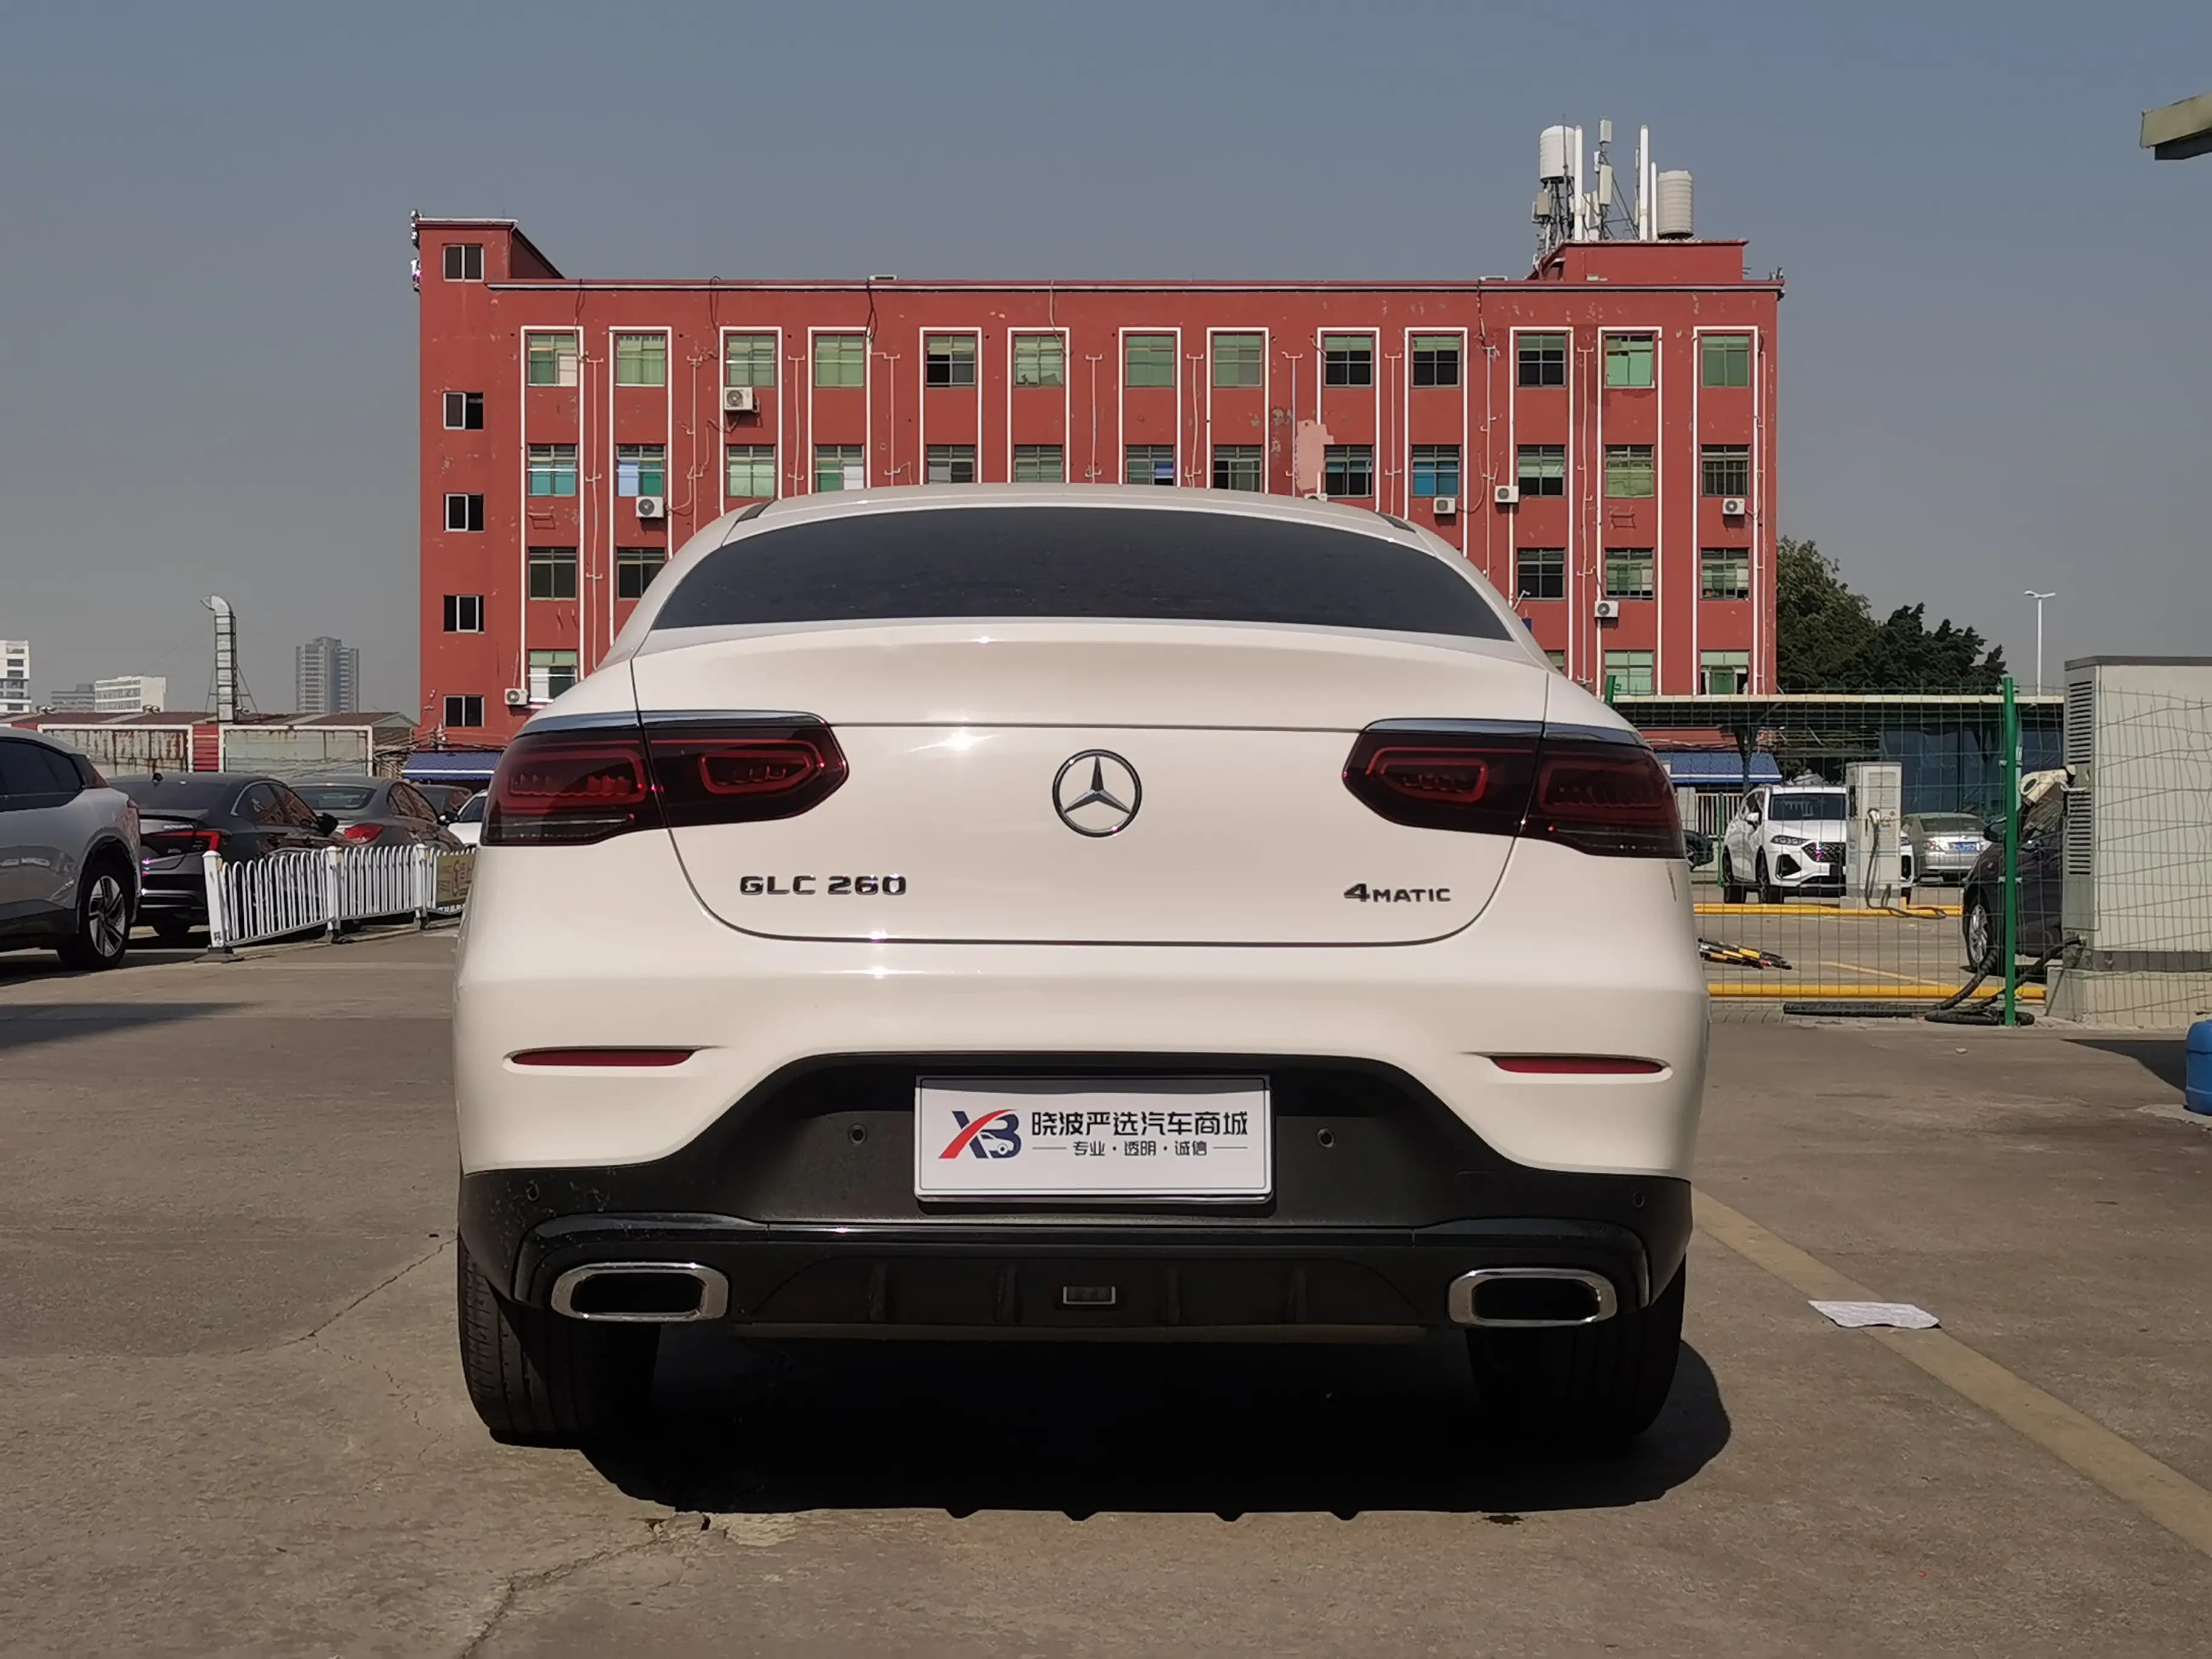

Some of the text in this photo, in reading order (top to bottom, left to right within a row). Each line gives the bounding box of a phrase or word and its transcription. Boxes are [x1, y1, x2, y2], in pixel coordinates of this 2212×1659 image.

[740, 874, 906, 895] GLC 260
[1344, 883, 1451, 902] 4MATIC
[1031, 1111, 1248, 1136] 晓波严选汽车商城
